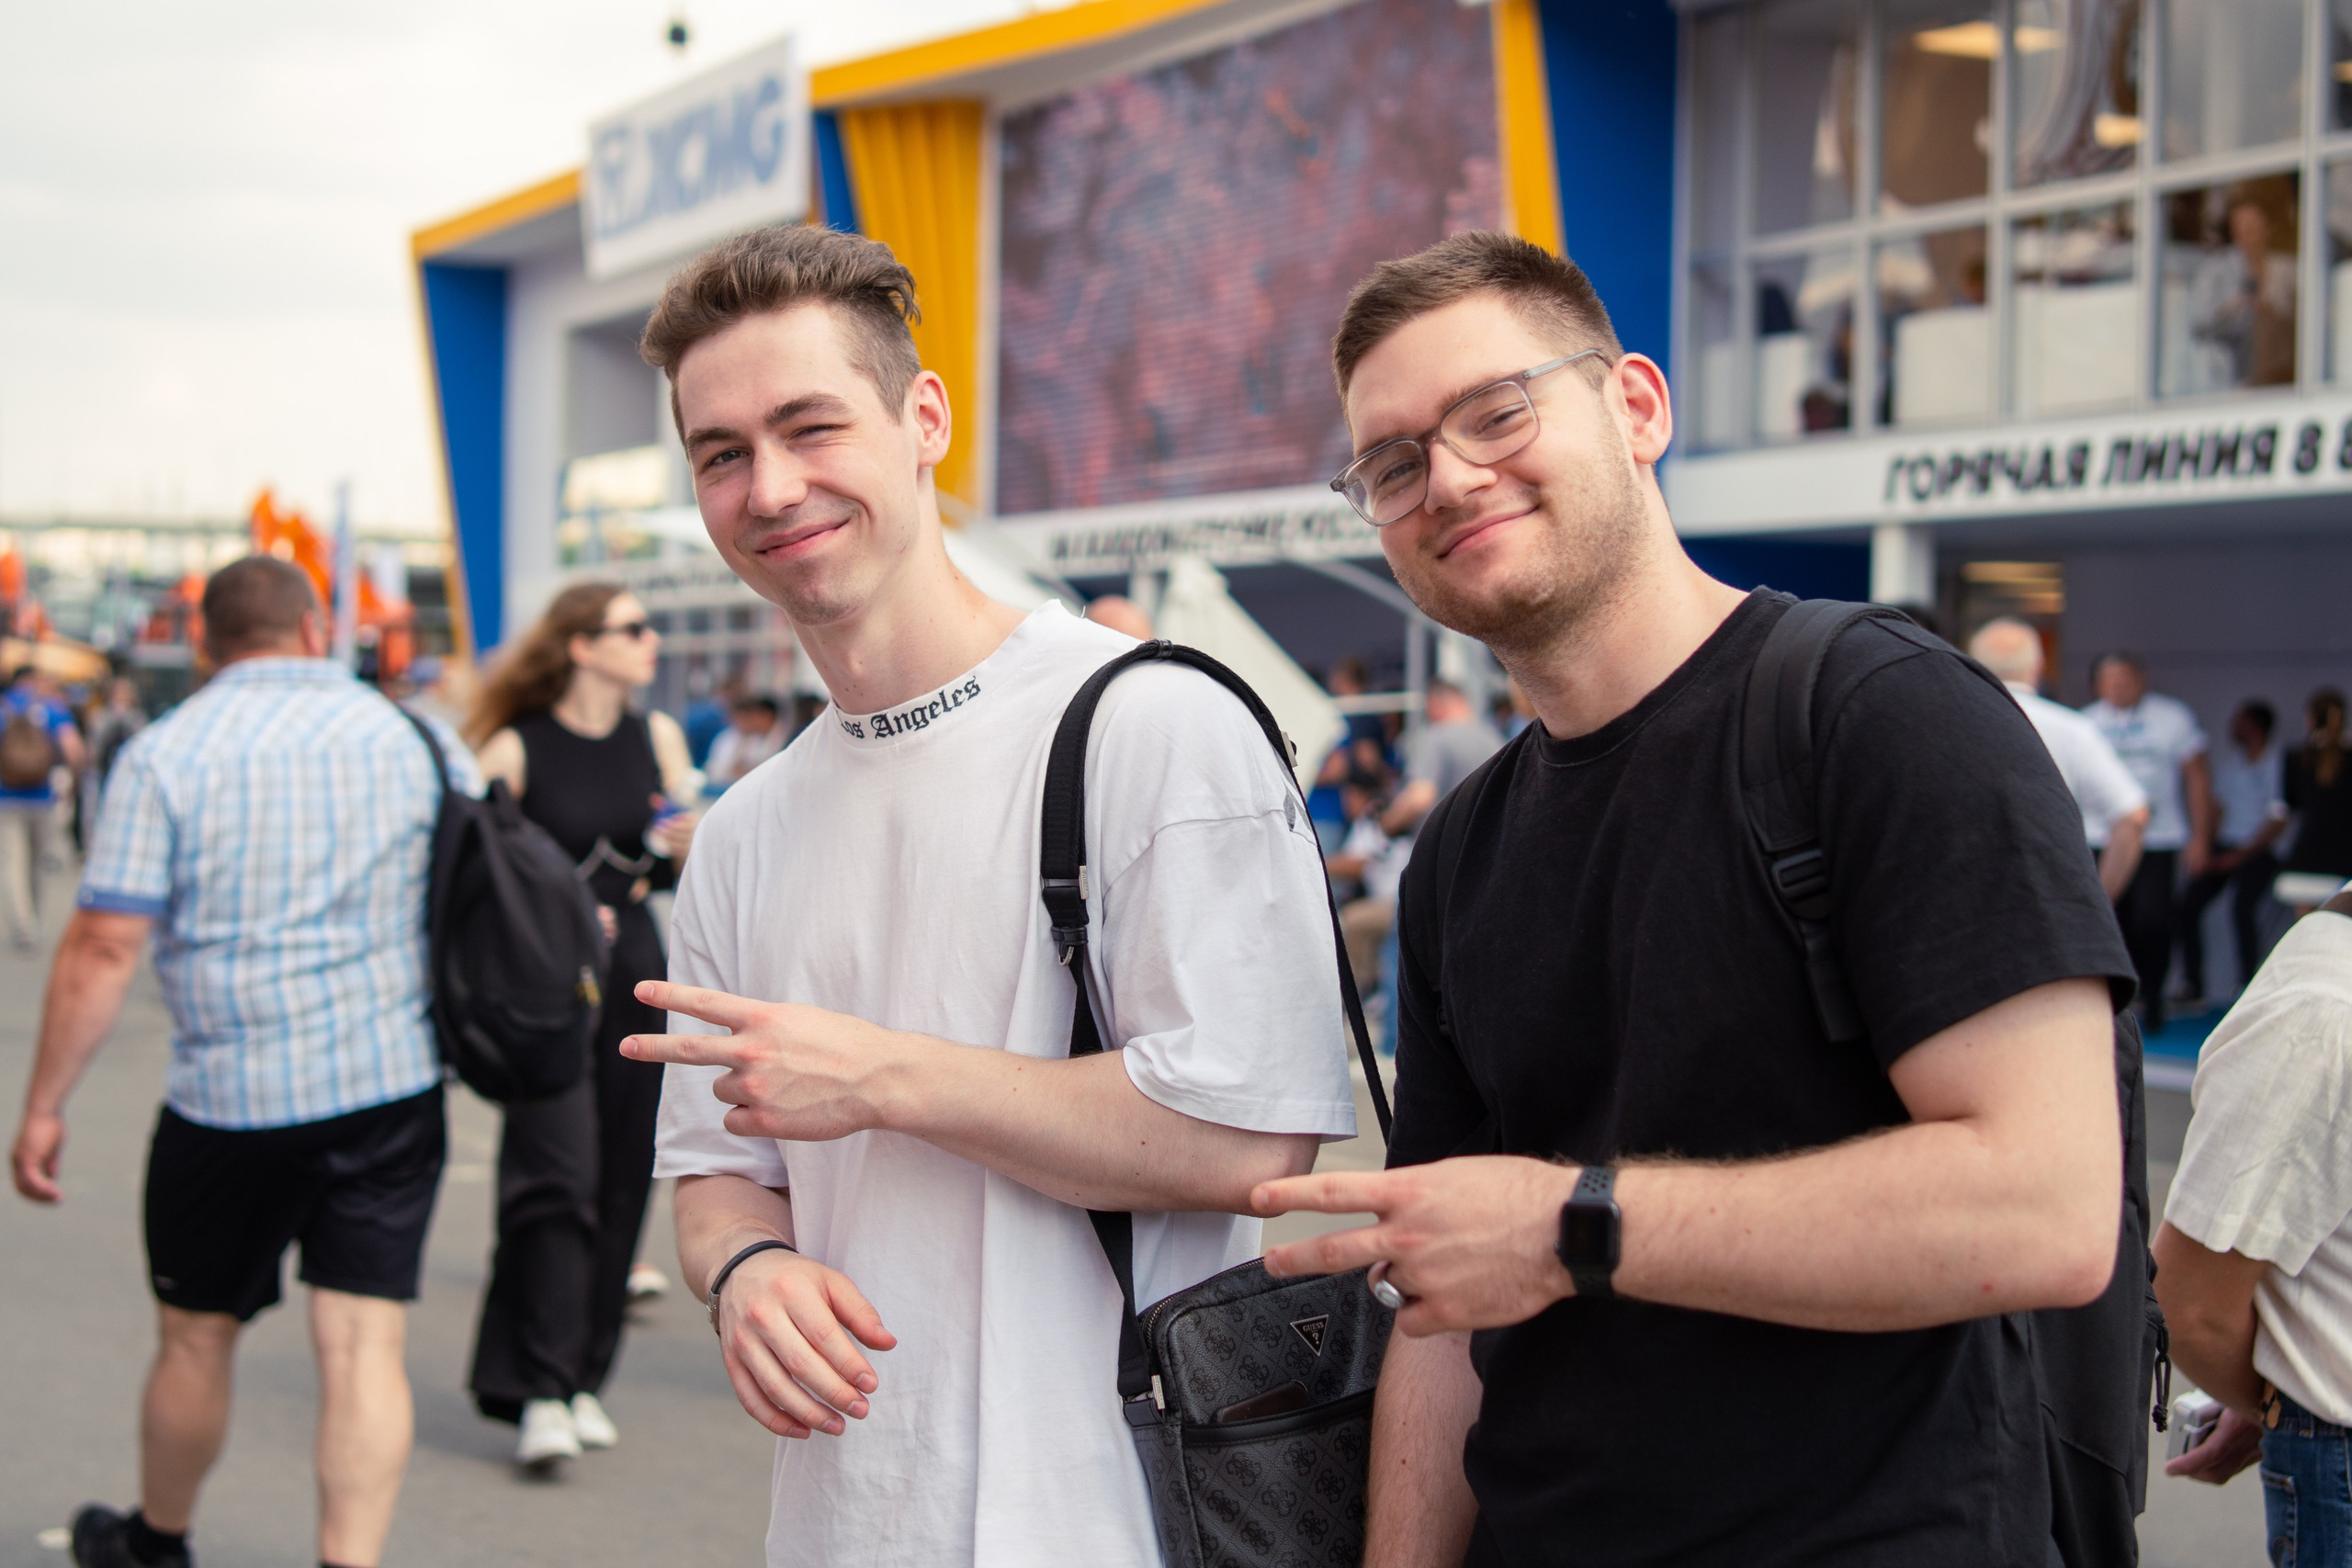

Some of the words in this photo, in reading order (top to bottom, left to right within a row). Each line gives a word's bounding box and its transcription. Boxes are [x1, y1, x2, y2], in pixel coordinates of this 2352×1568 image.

[1885, 440, 2092, 502] ГОРЯЧАЯ
[2103, 423, 2278, 487] ЛИНИЯ
[2295, 423, 2322, 474] 8
[871, 676, 980, 739] Angeles
[1303, 1321, 1324, 1332] GUESS
